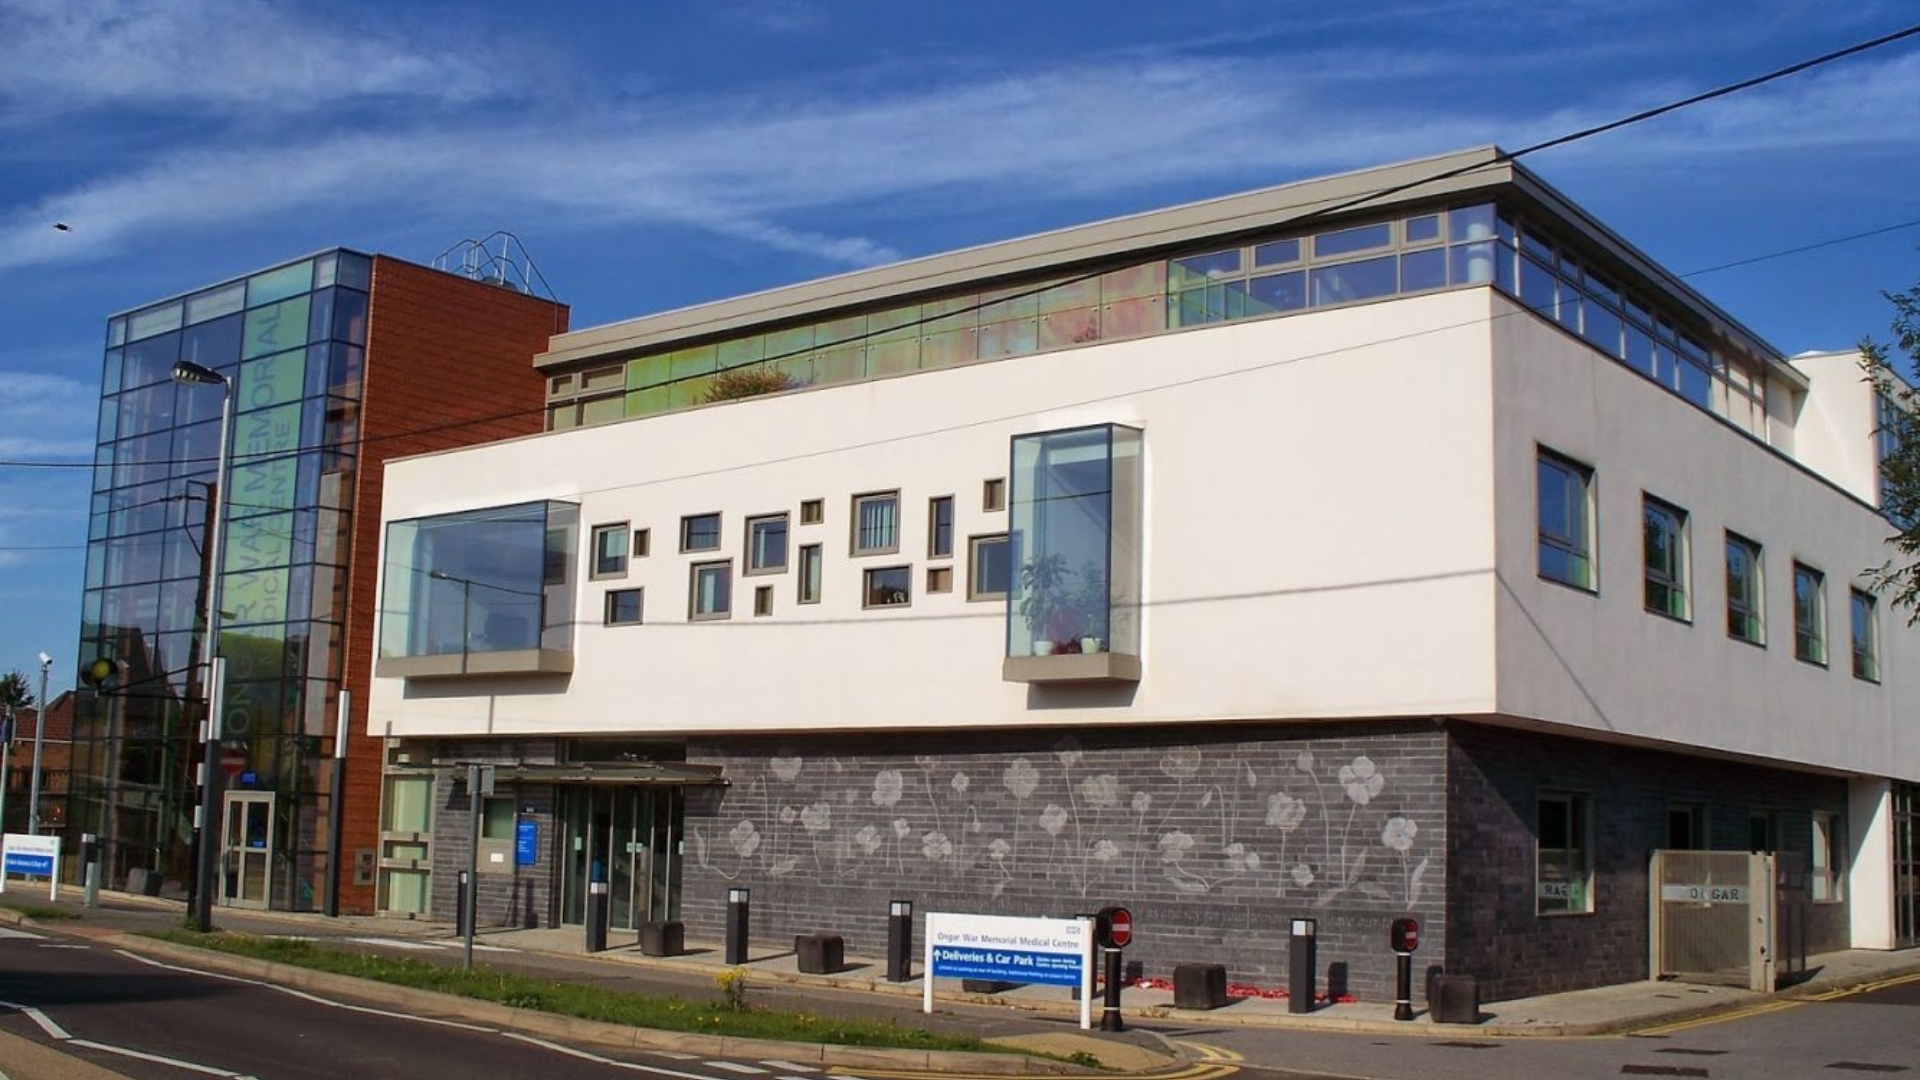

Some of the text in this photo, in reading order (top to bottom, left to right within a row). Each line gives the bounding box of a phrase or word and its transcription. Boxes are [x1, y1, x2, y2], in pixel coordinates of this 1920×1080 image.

[245, 302, 281, 492] MEMORAL
[937, 931, 1079, 949] Ongar War Memorial Medical Centre
[943, 950, 984, 963] Deliveries
[986, 952, 993, 963] &
[995, 953, 1011, 964] Car
[1013, 954, 1034, 966] Park
